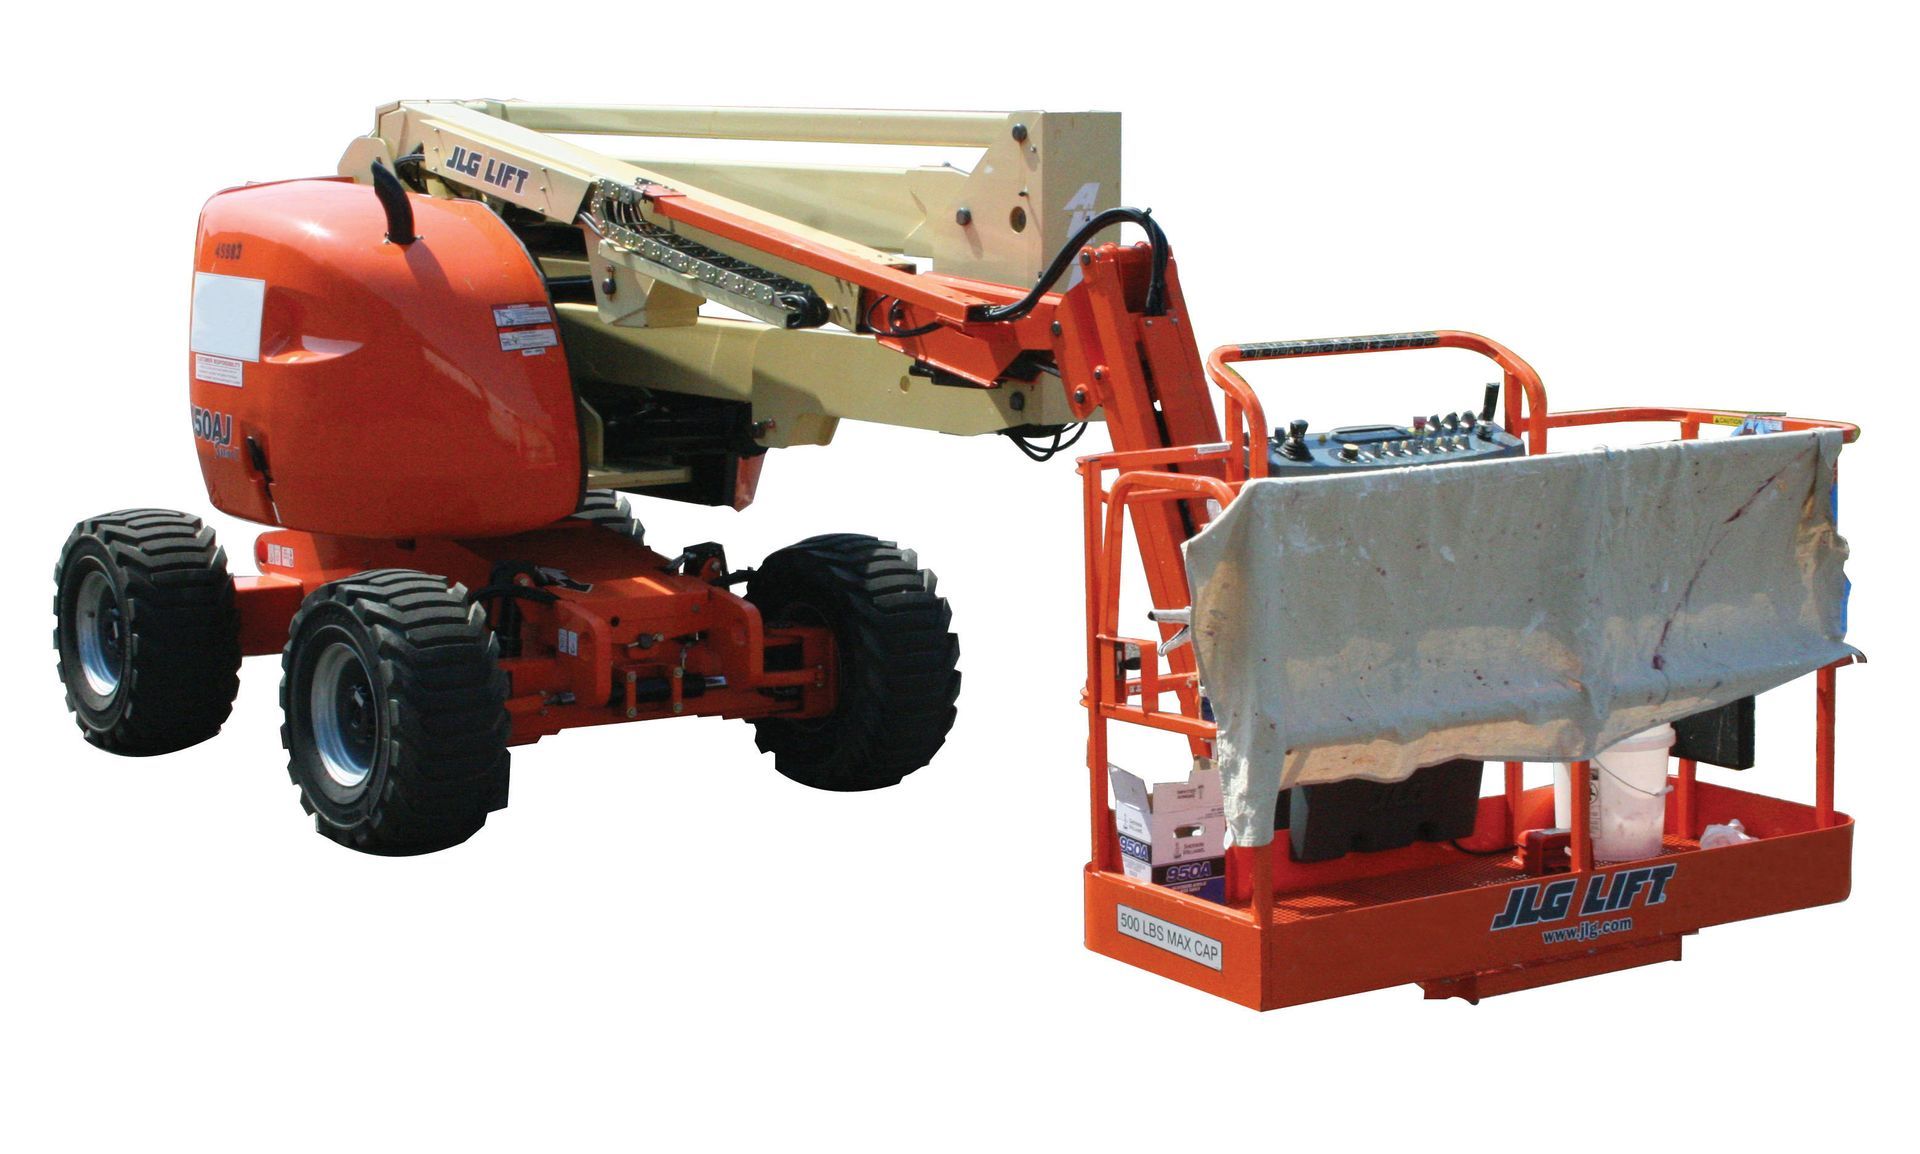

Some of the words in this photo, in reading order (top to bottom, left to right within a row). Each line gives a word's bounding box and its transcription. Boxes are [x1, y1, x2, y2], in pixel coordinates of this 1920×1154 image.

[446, 145, 482, 178] JLG
[484, 156, 530, 194] LIFT
[191, 405, 232, 447] 50AJ
[1120, 836, 1148, 861] 950A
[1166, 861, 1212, 882] 950A
[1490, 879, 1578, 931] JLG
[1579, 863, 1677, 916] LIFT
[1121, 913, 1140, 932] 500
[1143, 920, 1164, 941] LBS
[1167, 929, 1191, 952] MAX
[1194, 940, 1218, 960] CAP
[1542, 917, 1633, 944] www.jlg.com
